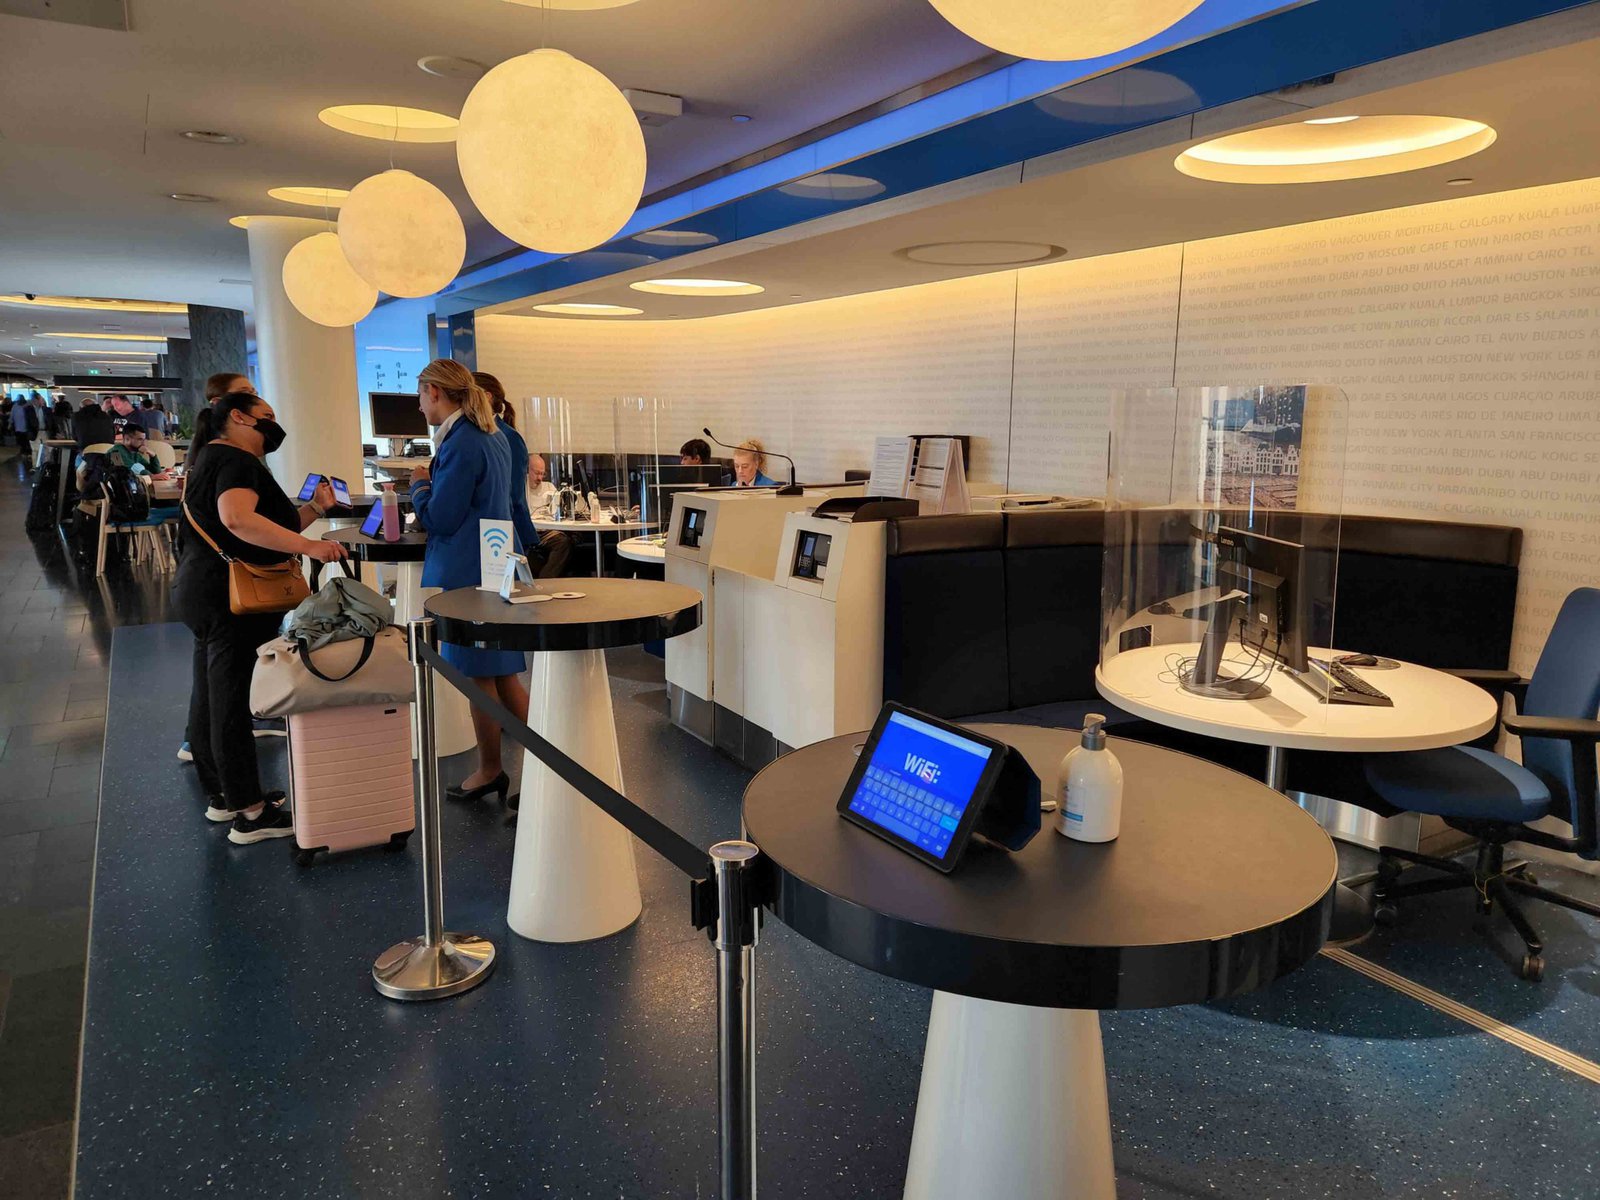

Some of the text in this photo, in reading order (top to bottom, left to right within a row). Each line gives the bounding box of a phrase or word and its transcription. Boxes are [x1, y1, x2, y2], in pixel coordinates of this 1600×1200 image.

[1329, 230, 1391, 249] VANCOUVER
[1395, 222, 1456, 238] MONTREAL
[1459, 213, 1514, 230] CALGARY
[1518, 207, 1559, 222] KUALA
[1332, 251, 1364, 263] TOKYO
[1368, 244, 1416, 258] MOSCOW
[1420, 241, 1449, 253] CAPE
[1454, 235, 1489, 249] TOWN
[1493, 230, 1543, 245] NAIROBI
[1548, 224, 1591, 239] ACCRA
[1329, 271, 1359, 282] DUBAI
[1362, 267, 1383, 279] ABU
[1386, 262, 1420, 276] DHABI
[1423, 257, 1471, 272] MUSCAT
[1474, 252, 1523, 266] AMMAN
[1527, 247, 1567, 262] CAIRO
[1573, 245, 1595, 257] TEL
[1317, 290, 1338, 301] CITY
[1341, 283, 1408, 298] PARAMARIBO
[1412, 279, 1447, 292] QUITO
[1451, 275, 1500, 288] HAVANA
[1504, 269, 1565, 284] HOUSTON
[1302, 306, 1355, 319] MONTREAL
[1358, 302, 1406, 314] CALGARY
[1409, 298, 1446, 310] KUALA
[1450, 293, 1499, 307] LUMPUR
[1503, 289, 1564, 304] BANGKOK
[1332, 323, 1357, 334] CAPE
[1361, 321, 1391, 332] TOWN
[1394, 318, 1440, 329] NAIROBI
[1444, 314, 1481, 326] ACCRA
[1486, 312, 1511, 324] DAR
[1516, 310, 1530, 322] ES
[1535, 308, 1589, 321] SALAAM
[1343, 339, 1384, 350] MUSCAT
[1388, 337, 1431, 349] AMMAN
[1435, 334, 1470, 346] CAIRO
[1475, 333, 1495, 344] TEL
[1499, 331, 1528, 343] AVIV
[1532, 328, 1586, 342] BUENOS
[1345, 357, 1376, 368] QUITO
[1379, 355, 1423, 367] HAVANA
[1426, 353, 1482, 365] HOUSTON
[1486, 351, 1516, 363] NEW
[1519, 350, 1553, 362] YORK
[1557, 349, 1582, 361] LOS
[1408, 372, 1454, 384] LUMPUR
[1459, 371, 1517, 383] BANGKOK
[1521, 370, 1590, 383] SHANGHAI
[1385, 392, 1397, 402] ES
[1401, 391, 1447, 402] SALAAM
[1451, 391, 1489, 401] LAGOS
[1374, 410, 1416, 420] BUENOS
[1420, 409, 1452, 420] AIRES
[1456, 410, 1477, 421] RIO
[1480, 410, 1497, 421] DE
[1501, 410, 1554, 422] JANEIRO
[1558, 411, 1591, 422] LIMA
[1382, 428, 1407, 438] NEW
[1411, 428, 1441, 439] YORK
[1444, 429, 1496, 439] ATLANTA
[1500, 430, 1525, 440] SAN
[1391, 446, 1449, 457] SHANGHAI
[1452, 447, 1496, 459] BEIJING
[1500, 450, 1537, 461] HONG
[1542, 450, 1578, 463] KONG
[1391, 464, 1421, 473] DELHI
[1425, 465, 1474, 476] MUMBAI
[1478, 467, 1515, 479] DUBAI
[1520, 469, 1546, 480] ABU
[1550, 471, 1591, 483] DHABI
[1410, 483, 1434, 492] CITY
[1438, 484, 1516, 498] PARAMARIBO
[1520, 489, 1560, 502] QUITO
[1381, 498, 1438, 512] MONTREAL
[1443, 503, 1497, 515] CALGARY
[1502, 506, 1542, 520] KUALA
[1529, 529, 1555, 541] DAR
[1560, 531, 1576, 543] ES
